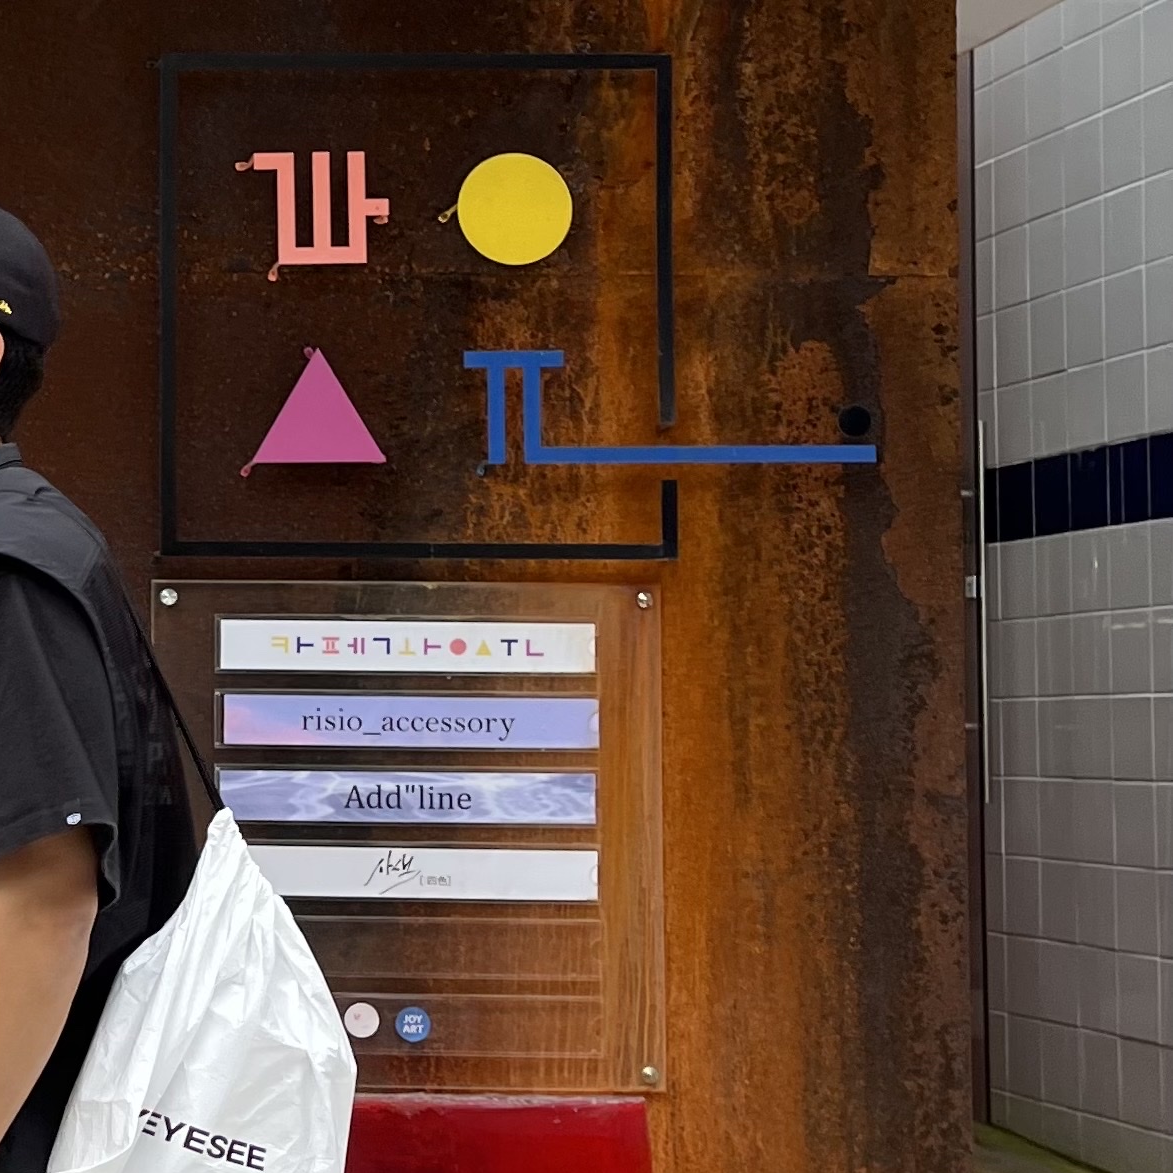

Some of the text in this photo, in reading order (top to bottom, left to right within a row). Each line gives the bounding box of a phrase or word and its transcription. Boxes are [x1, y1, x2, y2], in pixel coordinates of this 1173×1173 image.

[301, 707, 516, 742] risio_accessory
[344, 784, 473, 811] Add"line
[402, 1026, 426, 1037] ART
[403, 1015, 425, 1026] JOY
[138, 1108, 267, 1172] EYESEE
